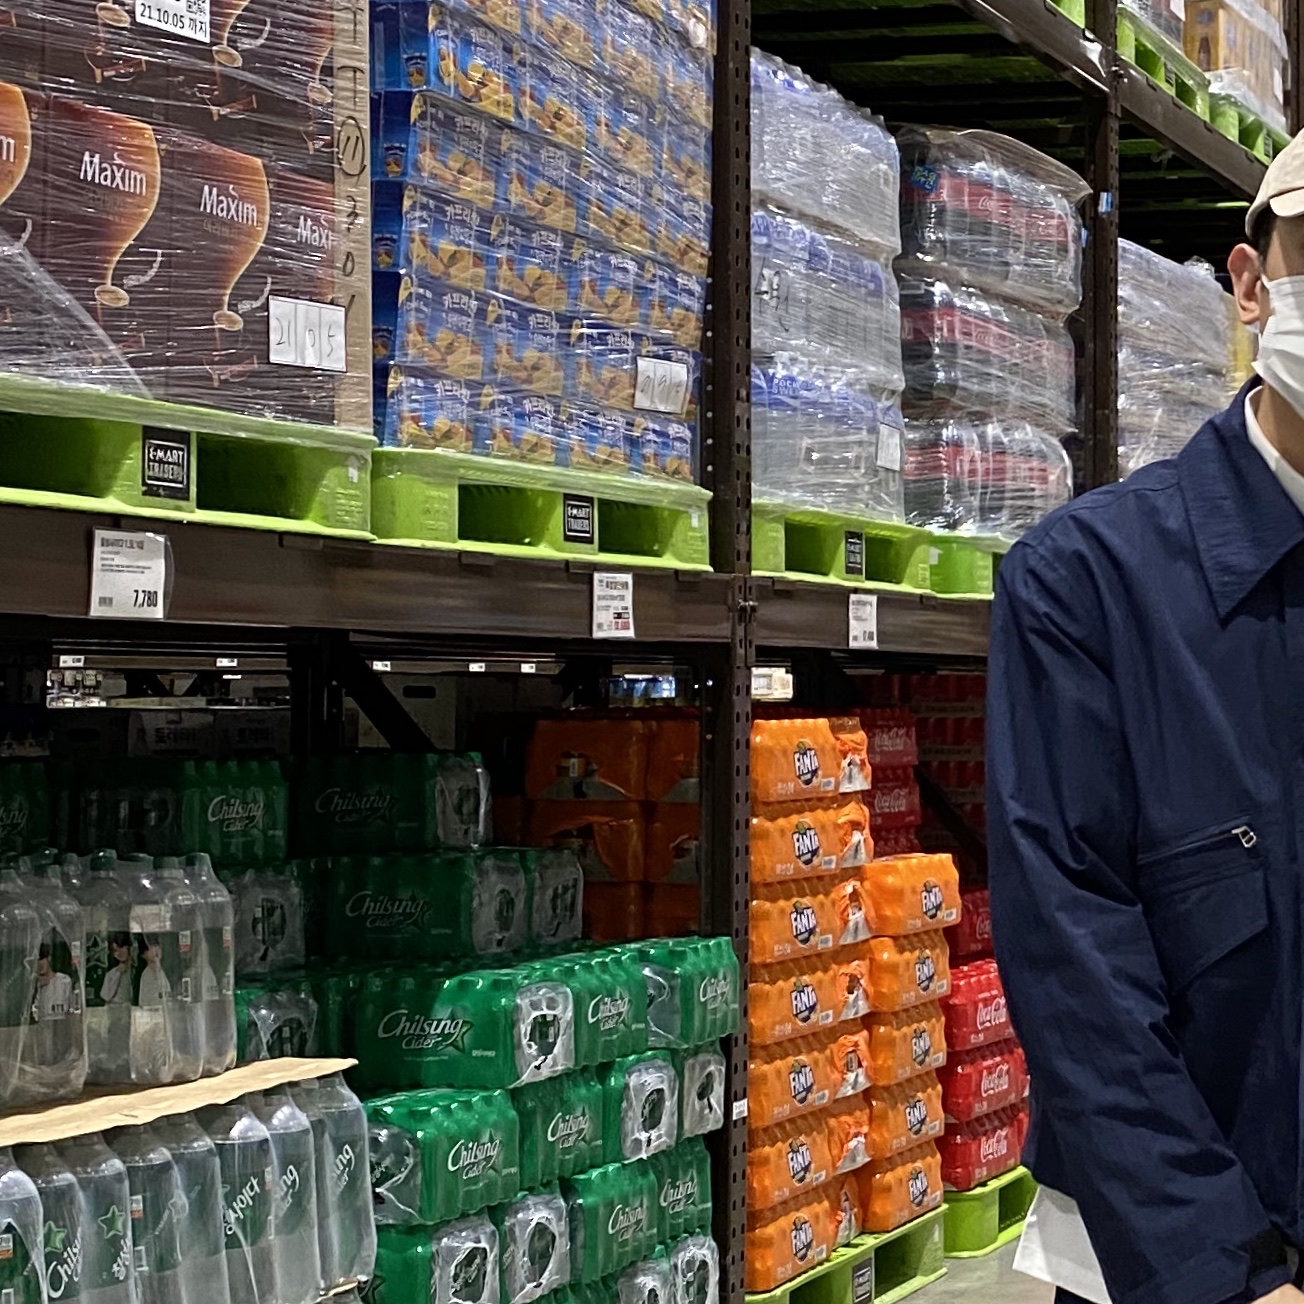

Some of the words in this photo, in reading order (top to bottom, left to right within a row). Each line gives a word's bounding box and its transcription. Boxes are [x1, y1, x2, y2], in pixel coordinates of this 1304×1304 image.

[80, 150, 147, 197] Maxim
[200, 185, 258, 227] Maxim
[297, 214, 336, 250] Maxi
[133, 589, 158, 609] 7,780
[794, 750, 819, 775] FANTA
[793, 829, 820, 857] FANTA
[921, 887, 943, 910] FANTA
[790, 907, 817, 936] FANTA
[791, 984, 817, 1013] FANTA
[789, 1066, 814, 1093] FANTA
[905, 1100, 927, 1128] FANTA
[787, 1144, 812, 1174] FANTA
[908, 1172, 928, 1199] FANTA
[225, 1176, 261, 1236] 사이다
[790, 1223, 813, 1253] FANTA
